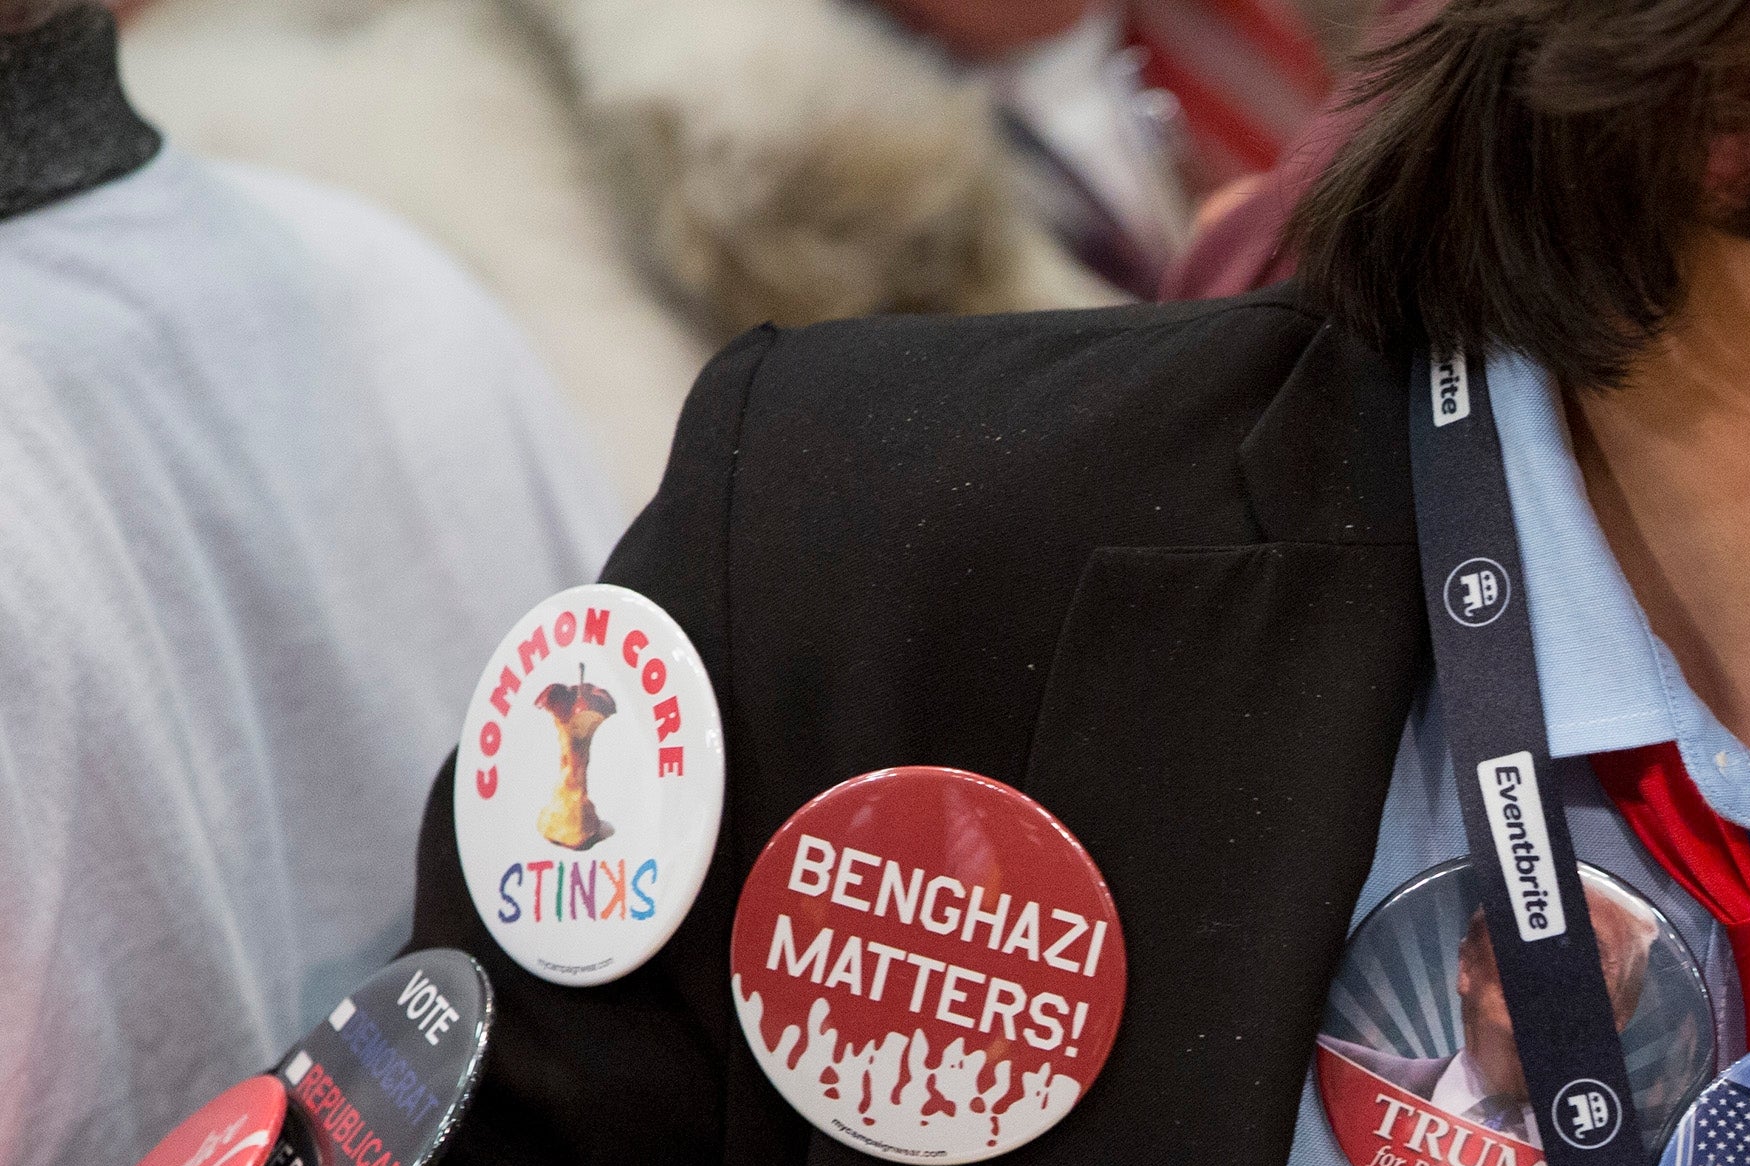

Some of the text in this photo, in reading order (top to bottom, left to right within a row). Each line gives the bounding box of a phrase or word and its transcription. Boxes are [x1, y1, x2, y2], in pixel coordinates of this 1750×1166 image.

[476, 607, 684, 800] COMMON CORE
[499, 858, 659, 924] STINKS
[788, 834, 1108, 977] BENGHAZI
[1493, 765, 1547, 930] Eventbrite
[398, 969, 460, 1046] VOTE
[766, 914, 1089, 1058] MATTERS!
